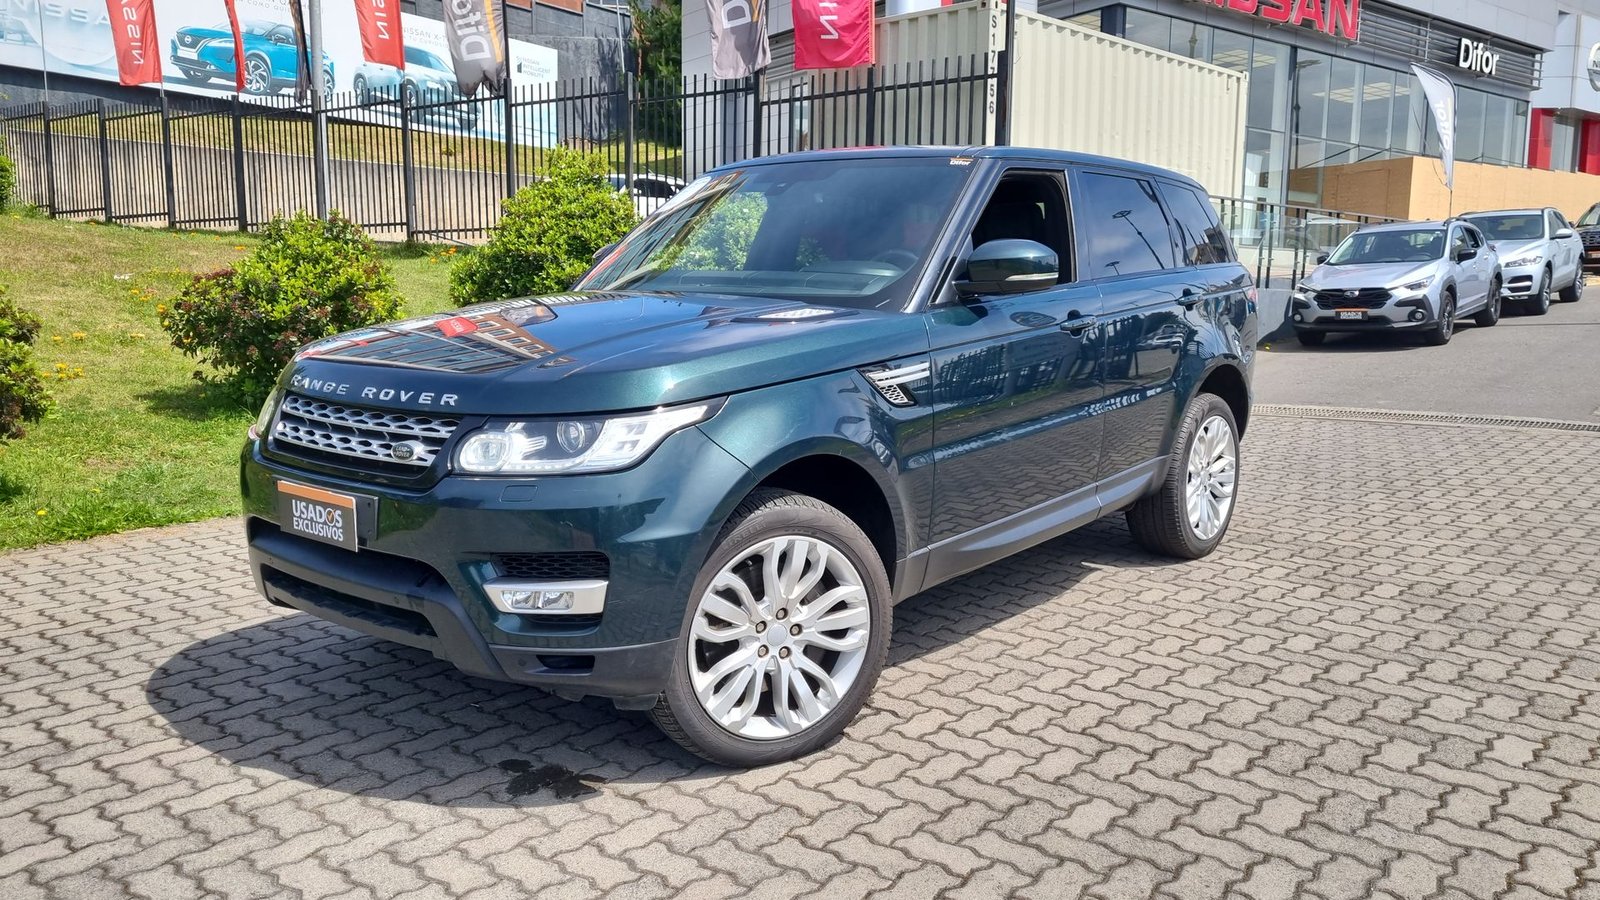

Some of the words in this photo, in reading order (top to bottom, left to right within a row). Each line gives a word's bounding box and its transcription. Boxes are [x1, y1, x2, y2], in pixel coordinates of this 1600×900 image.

[1459, 37, 1500, 75] Difor
[290, 374, 350, 396] RANGE
[361, 385, 459, 406] ROVER
[291, 499, 343, 529] USADOS
[292, 516, 344, 542] EXCLUSIVOS
